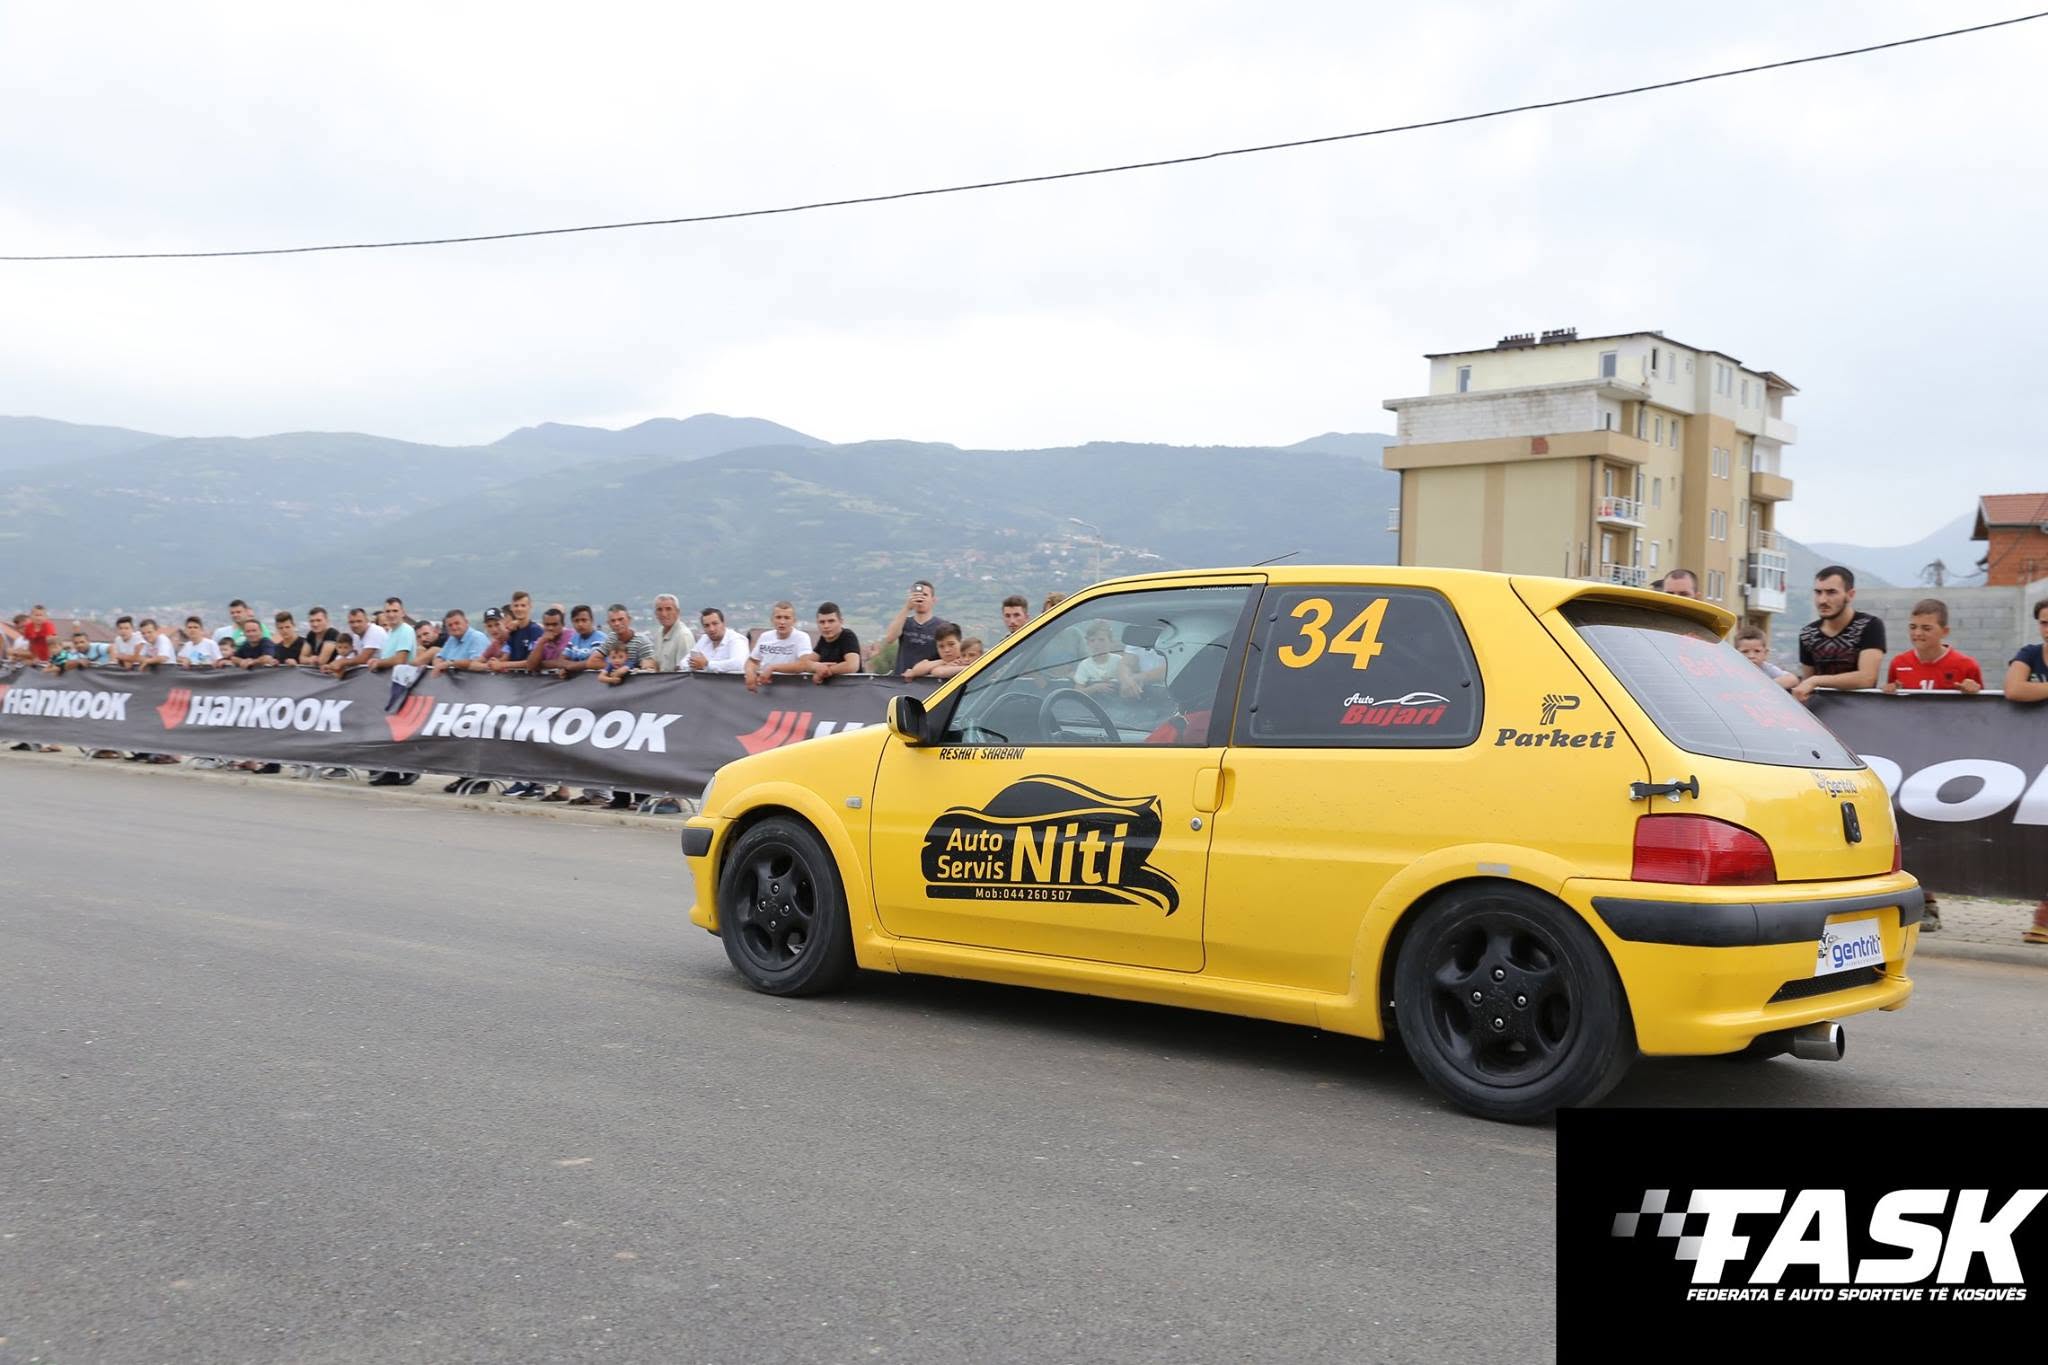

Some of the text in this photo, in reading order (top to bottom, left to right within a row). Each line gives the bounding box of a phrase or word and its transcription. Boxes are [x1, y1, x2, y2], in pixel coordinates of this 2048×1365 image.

[1278, 598, 1389, 670] 34
[1344, 693, 1374, 707] Auto
[1341, 705, 1446, 726] Bujari
[1495, 729, 1615, 748] Parketi
[940, 748, 1025, 761] RESHAT SHABANI
[946, 828, 1003, 852] Auto
[1010, 823, 1128, 884] Niti
[937, 856, 1004, 880] Servis
[1027, 889, 1049, 900] 260
[1051, 890, 1072, 901] 507
[1832, 934, 1881, 969] gentriti
